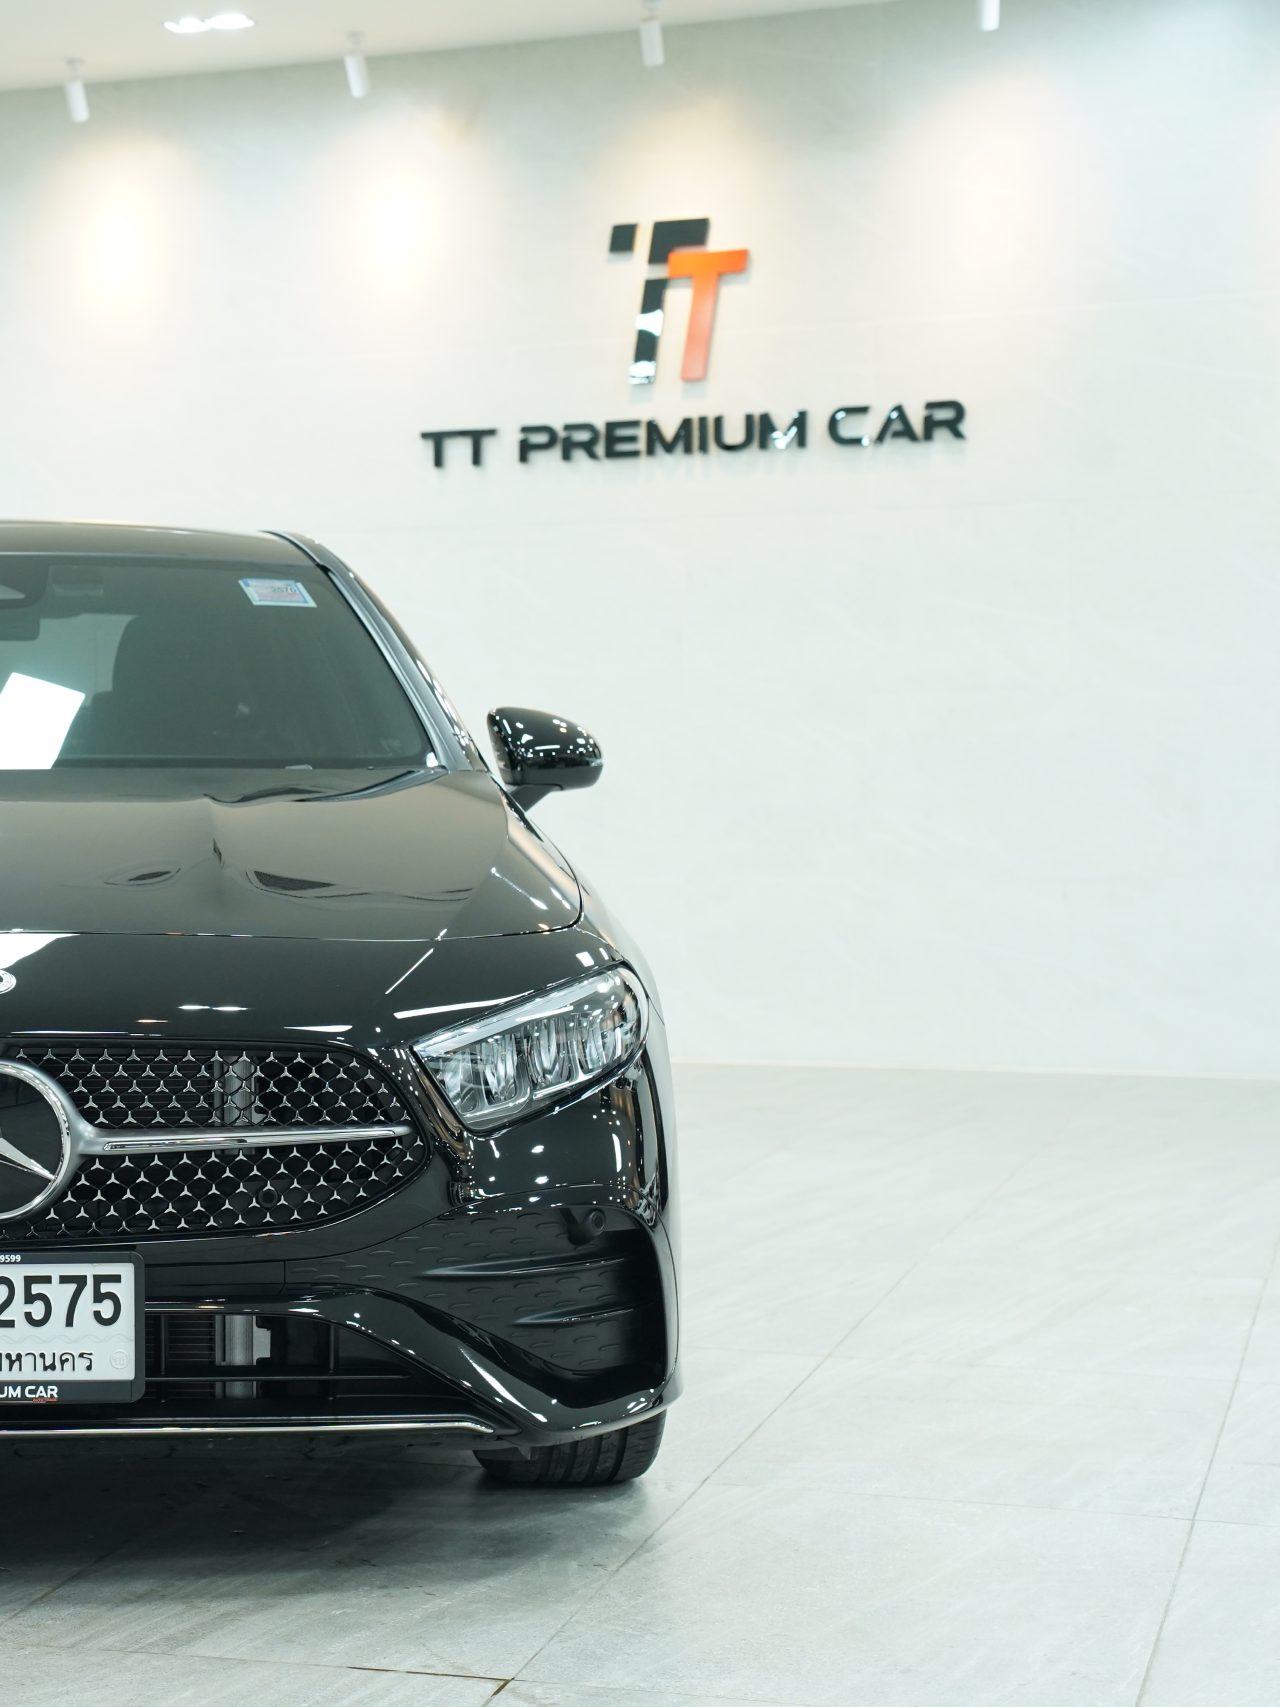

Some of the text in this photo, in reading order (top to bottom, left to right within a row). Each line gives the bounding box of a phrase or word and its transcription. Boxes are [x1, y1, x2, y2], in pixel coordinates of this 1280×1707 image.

[420, 400, 967, 468] TT PREMIUM CAR
[24, 1385, 58, 1398] CAR
